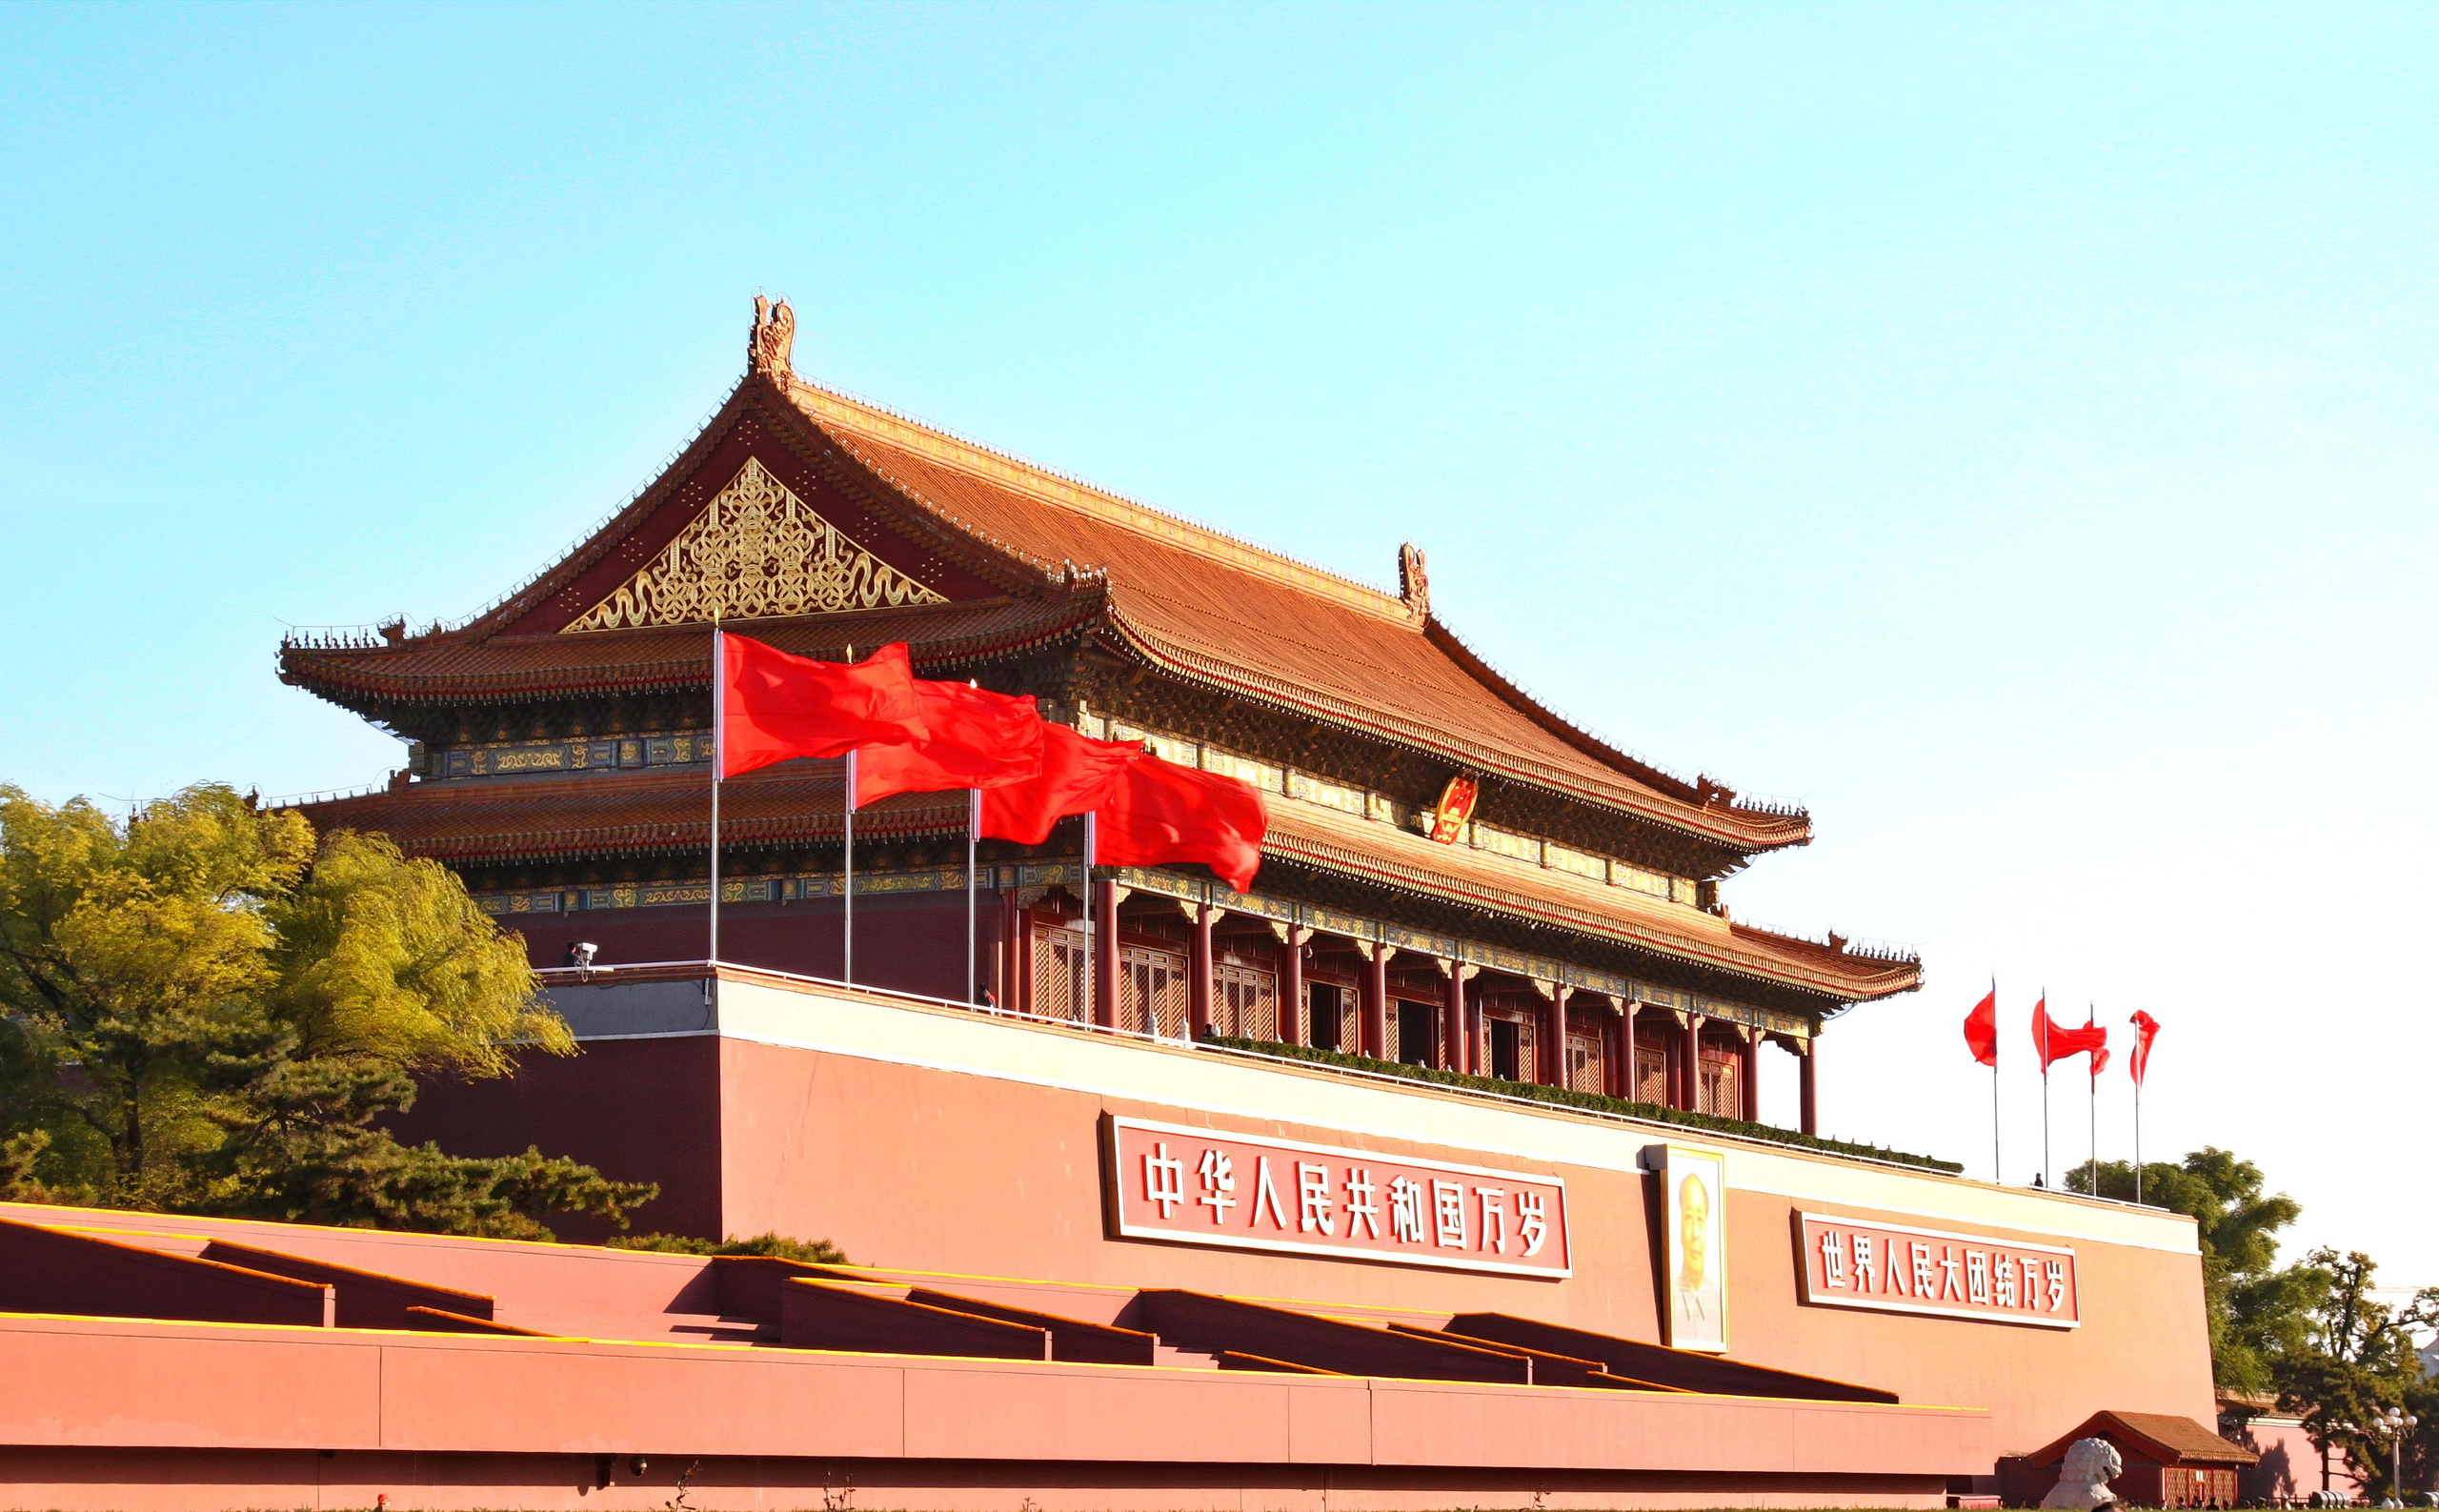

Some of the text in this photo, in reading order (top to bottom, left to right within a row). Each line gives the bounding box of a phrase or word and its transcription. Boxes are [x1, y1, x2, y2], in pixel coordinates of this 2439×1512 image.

[1143, 1141, 1548, 1257] 中华人民共和国万岁
[1821, 1230, 2066, 1313] 世界人民大团结万岁
